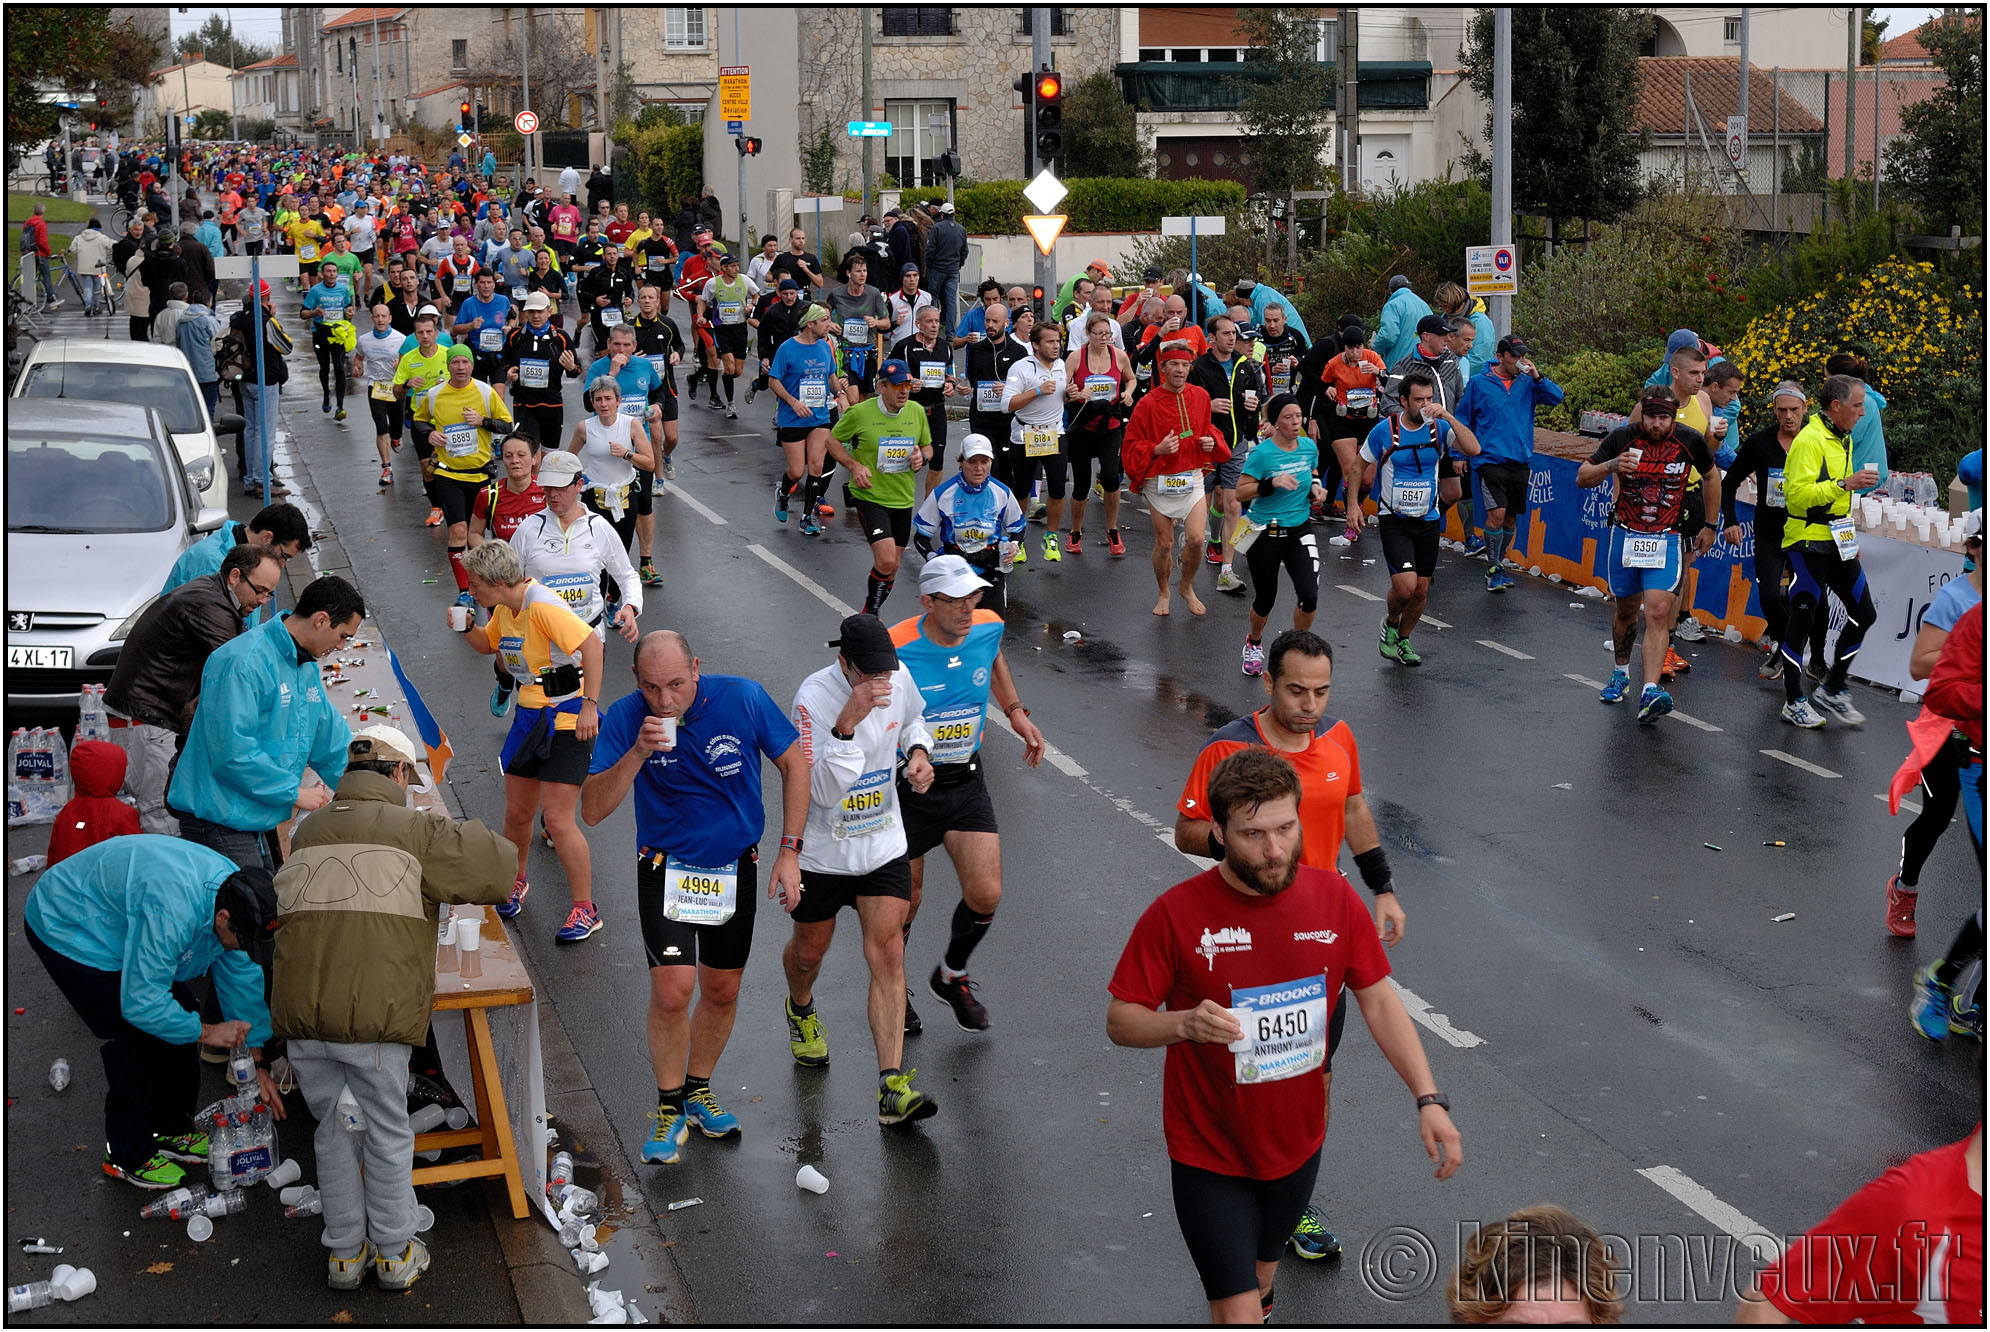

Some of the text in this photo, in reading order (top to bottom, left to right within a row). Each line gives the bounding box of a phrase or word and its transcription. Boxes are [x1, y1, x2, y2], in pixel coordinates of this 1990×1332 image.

[721, 67, 748, 75] ATTENTION
[451, 432, 471, 444] 6889
[1033, 433, 1047, 443] 618
[887, 448, 907, 459] 5232
[1166, 477, 1187, 488] 5204
[1402, 490, 1424, 502] 6647
[1583, 496, 1595, 517] LA
[1633, 540, 1658, 553] 6350
[555, 576, 591, 585] BROOKS
[24, 649, 45, 666] XL
[51, 650, 69, 667] 17
[940, 705, 980, 719] BROOKS
[937, 722, 970, 741] 5295
[17, 759, 52, 768] JOLIVAL
[714, 761, 743, 773] RUNNING
[847, 790, 881, 812] 4676
[681, 875, 721, 897] 4994
[677, 895, 708, 906] JEAN-LUC
[1258, 983, 1323, 1006] BROOKS
[1258, 1008, 1308, 1042] 6450
[1254, 1040, 1293, 1057] ANTHONY
[1259, 1051, 1310, 1072] MARATHON
[236, 1153, 265, 1167] JOLIVAL
